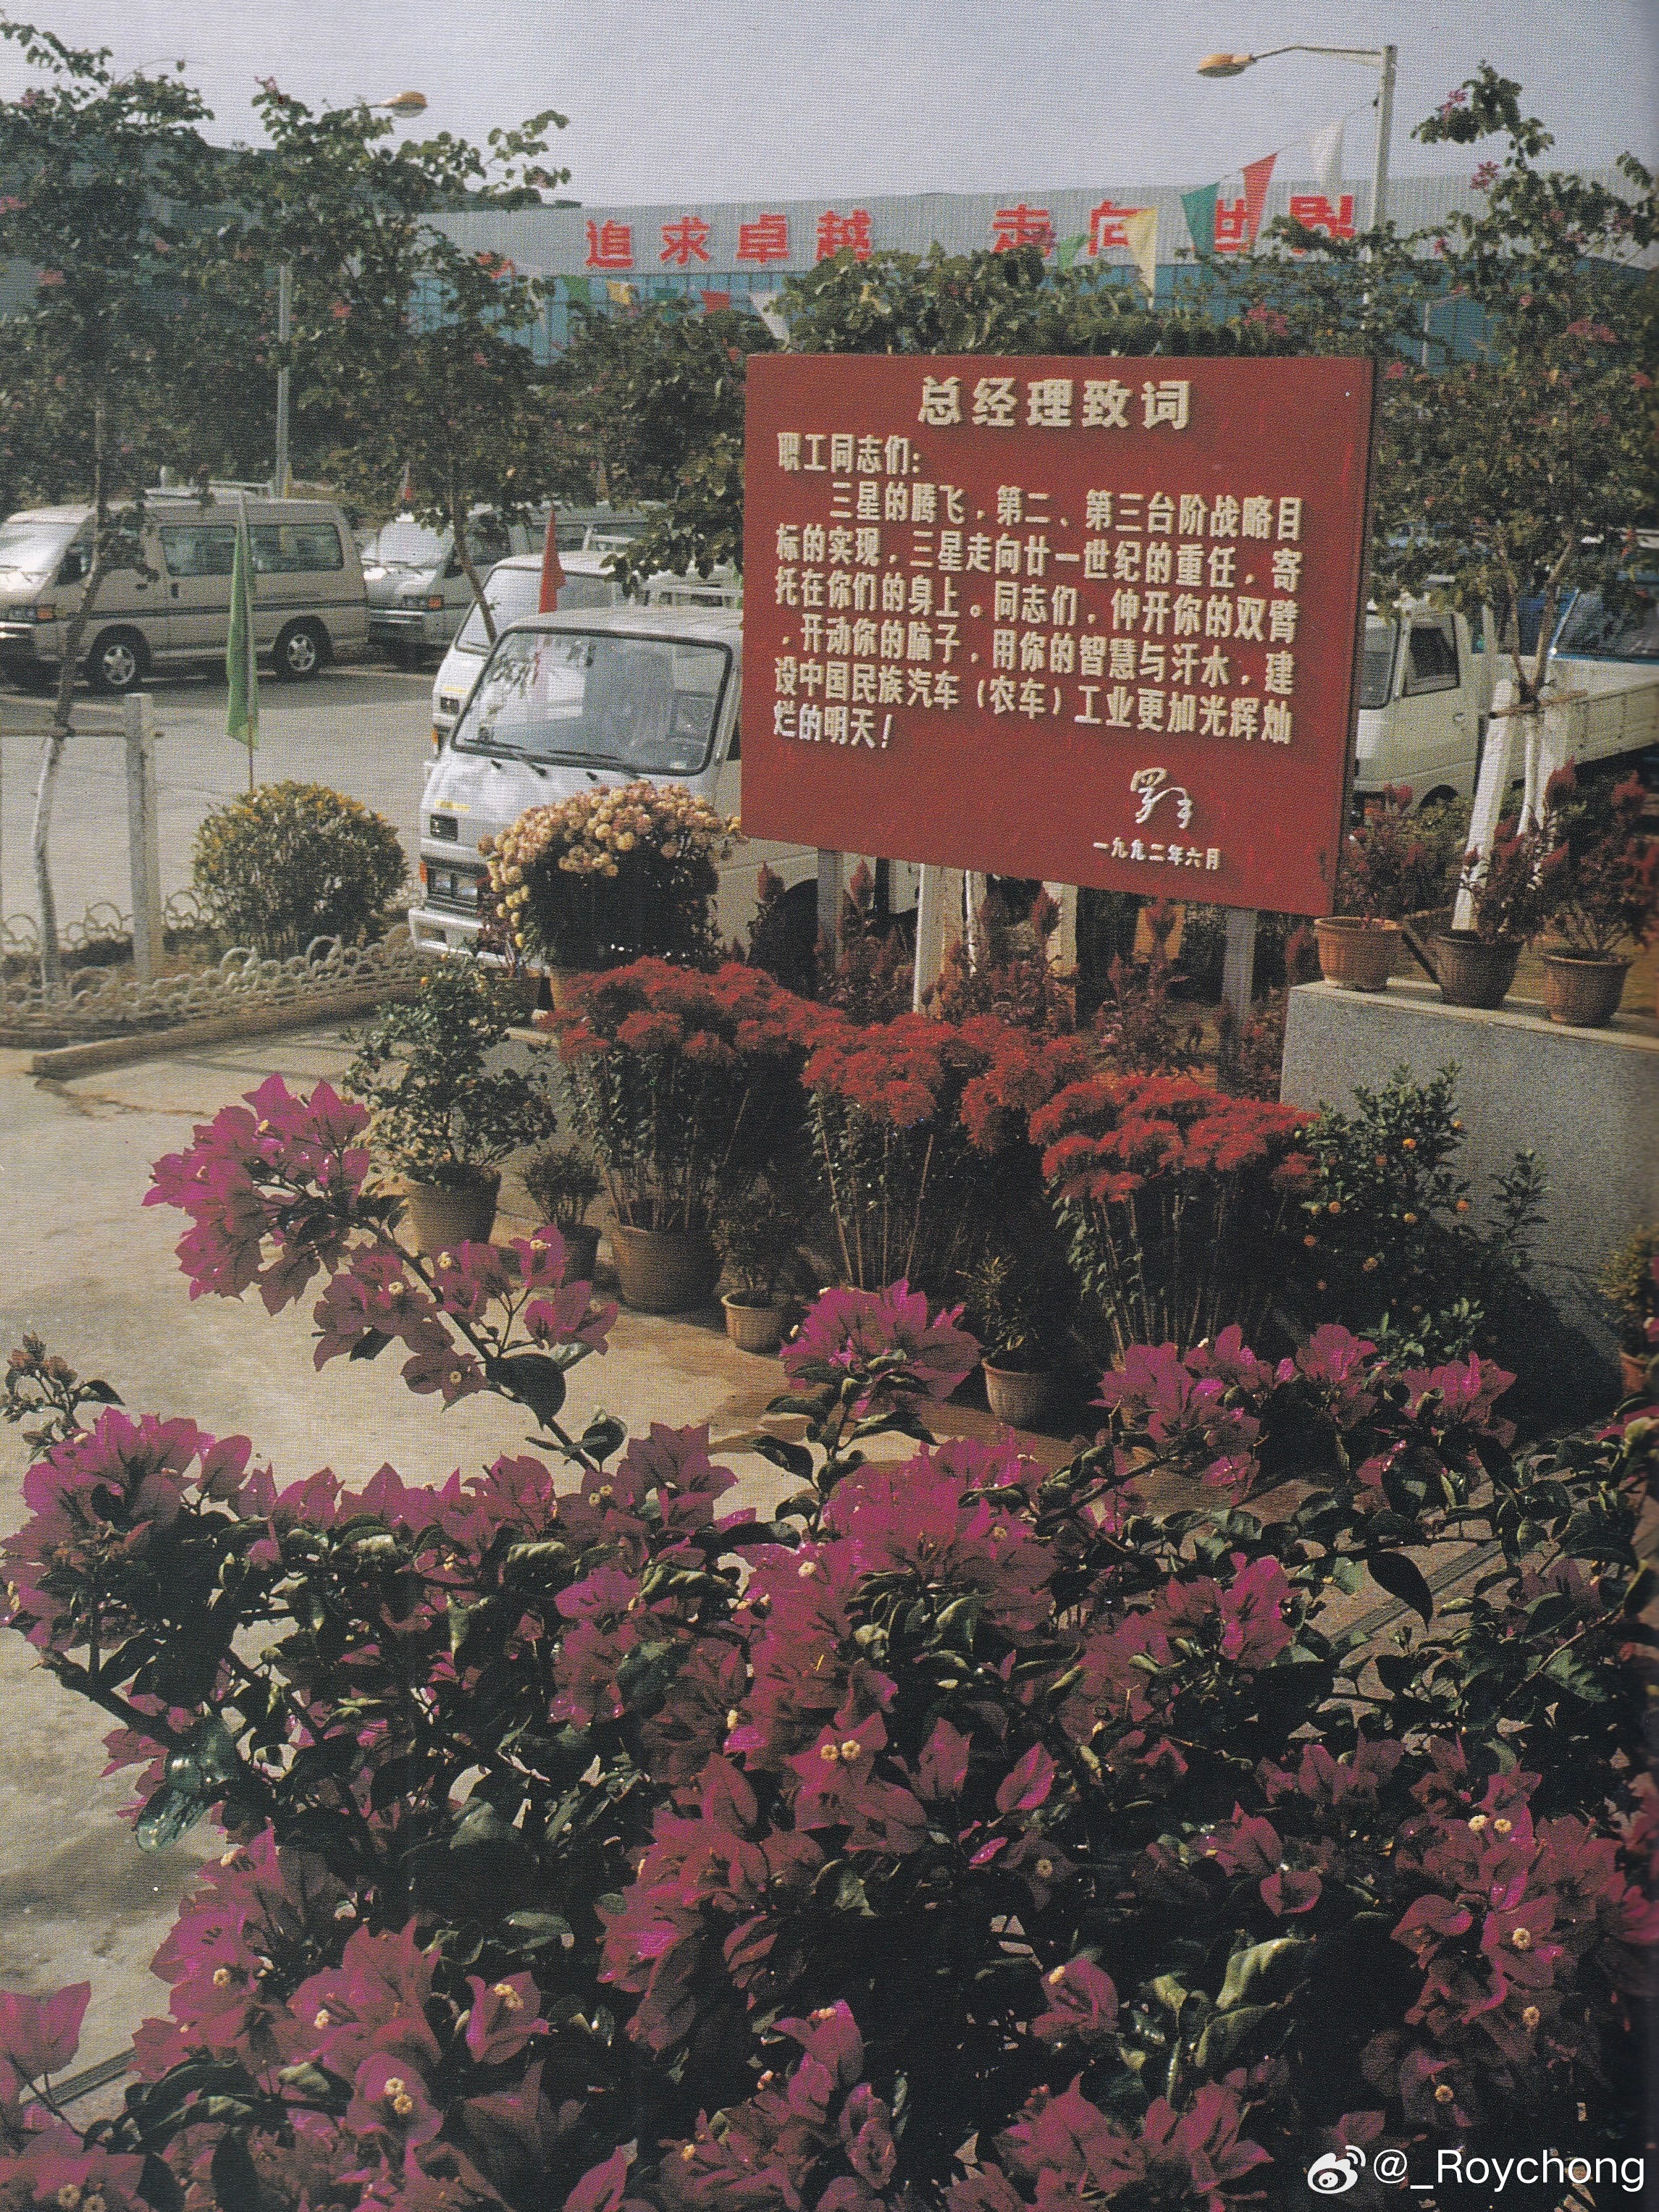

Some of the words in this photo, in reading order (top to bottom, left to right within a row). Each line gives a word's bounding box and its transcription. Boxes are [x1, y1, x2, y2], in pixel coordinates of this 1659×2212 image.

[585, 209, 873, 269] 追求卓越
[918, 375, 1192, 430] 总经理致词
[1093, 836, 1222, 870] 一九九二年六月
